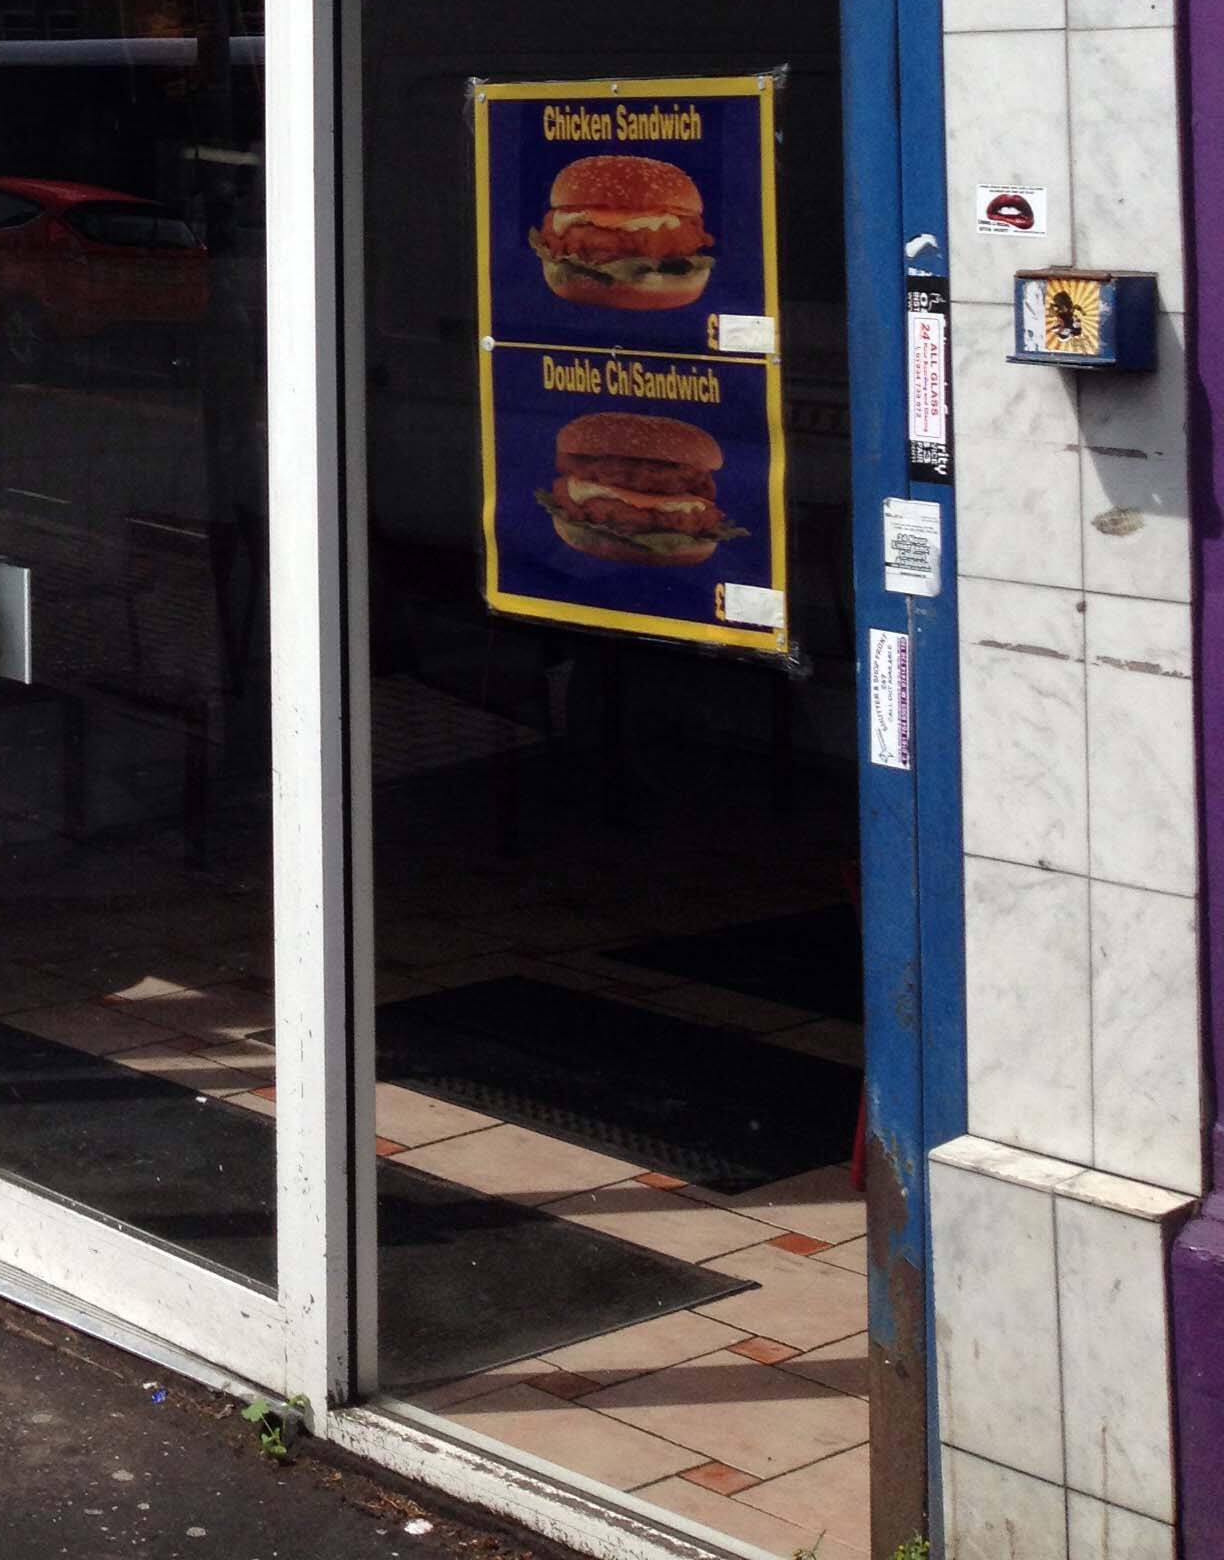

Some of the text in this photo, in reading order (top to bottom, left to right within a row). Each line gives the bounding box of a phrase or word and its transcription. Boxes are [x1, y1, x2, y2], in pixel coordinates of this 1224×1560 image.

[543, 104, 703, 141] Chicken Sandwich
[919, 322, 931, 341] 24
[542, 355, 601, 394] Double
[929, 343, 939, 416] ALL GLASS
